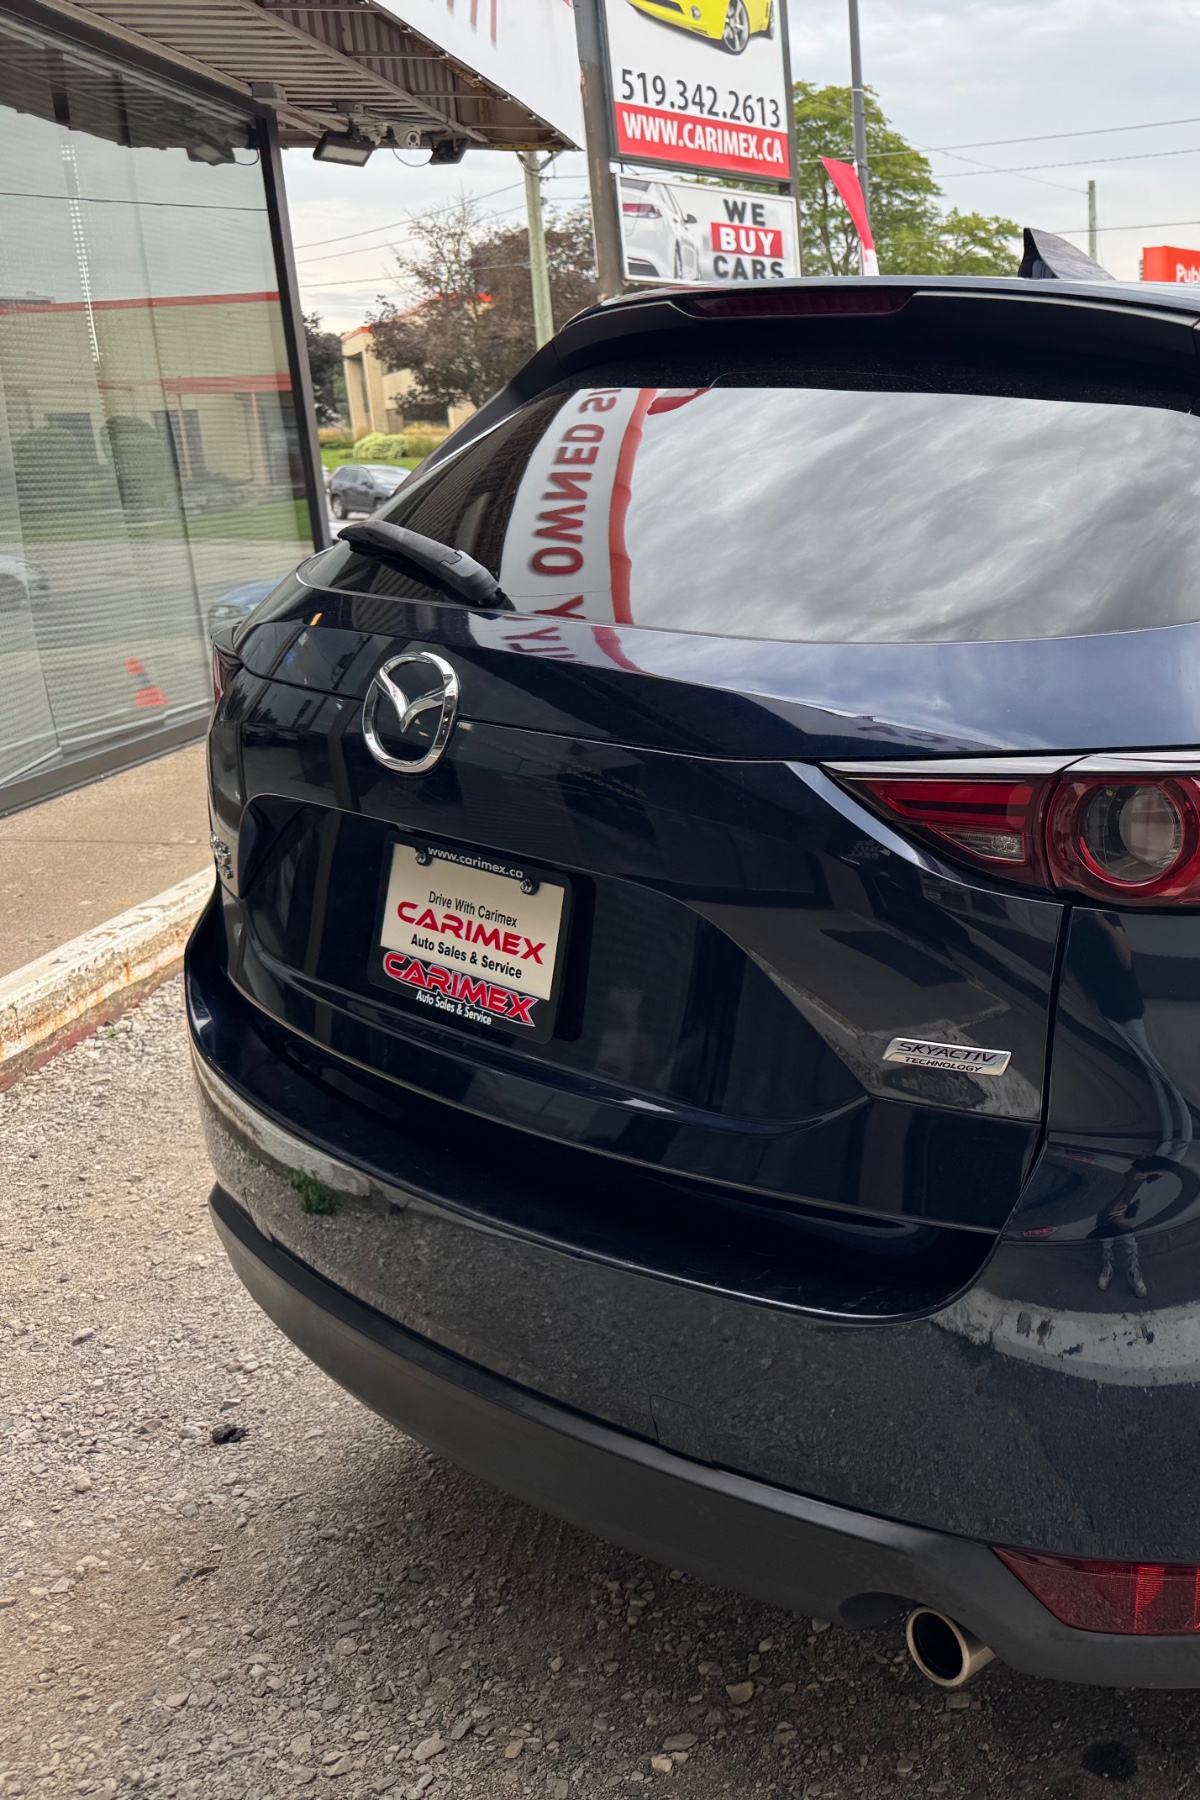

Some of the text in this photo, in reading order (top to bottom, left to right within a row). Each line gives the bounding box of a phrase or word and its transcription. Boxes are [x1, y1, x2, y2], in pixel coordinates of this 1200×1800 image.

[621, 69, 780, 128] 519.342.2613
[622, 111, 784, 164] WWW.CARIMEX.CA
[723, 199, 766, 226] WE
[719, 226, 775, 256] BUY
[713, 256, 784, 280] CARS
[427, 847, 524, 879] www.carimex.ca
[428, 891, 518, 928] Drive With Carimex
[397, 901, 547, 966] CARIMEX
[410, 933, 523, 979] Auto Sales & Service
[384, 953, 537, 1024] CARIMEX
[416, 990, 492, 1025] Auto Sales & Service
[896, 1041, 997, 1063] SKYACTIV
[904, 1056, 983, 1072] TECHNOLOGY
